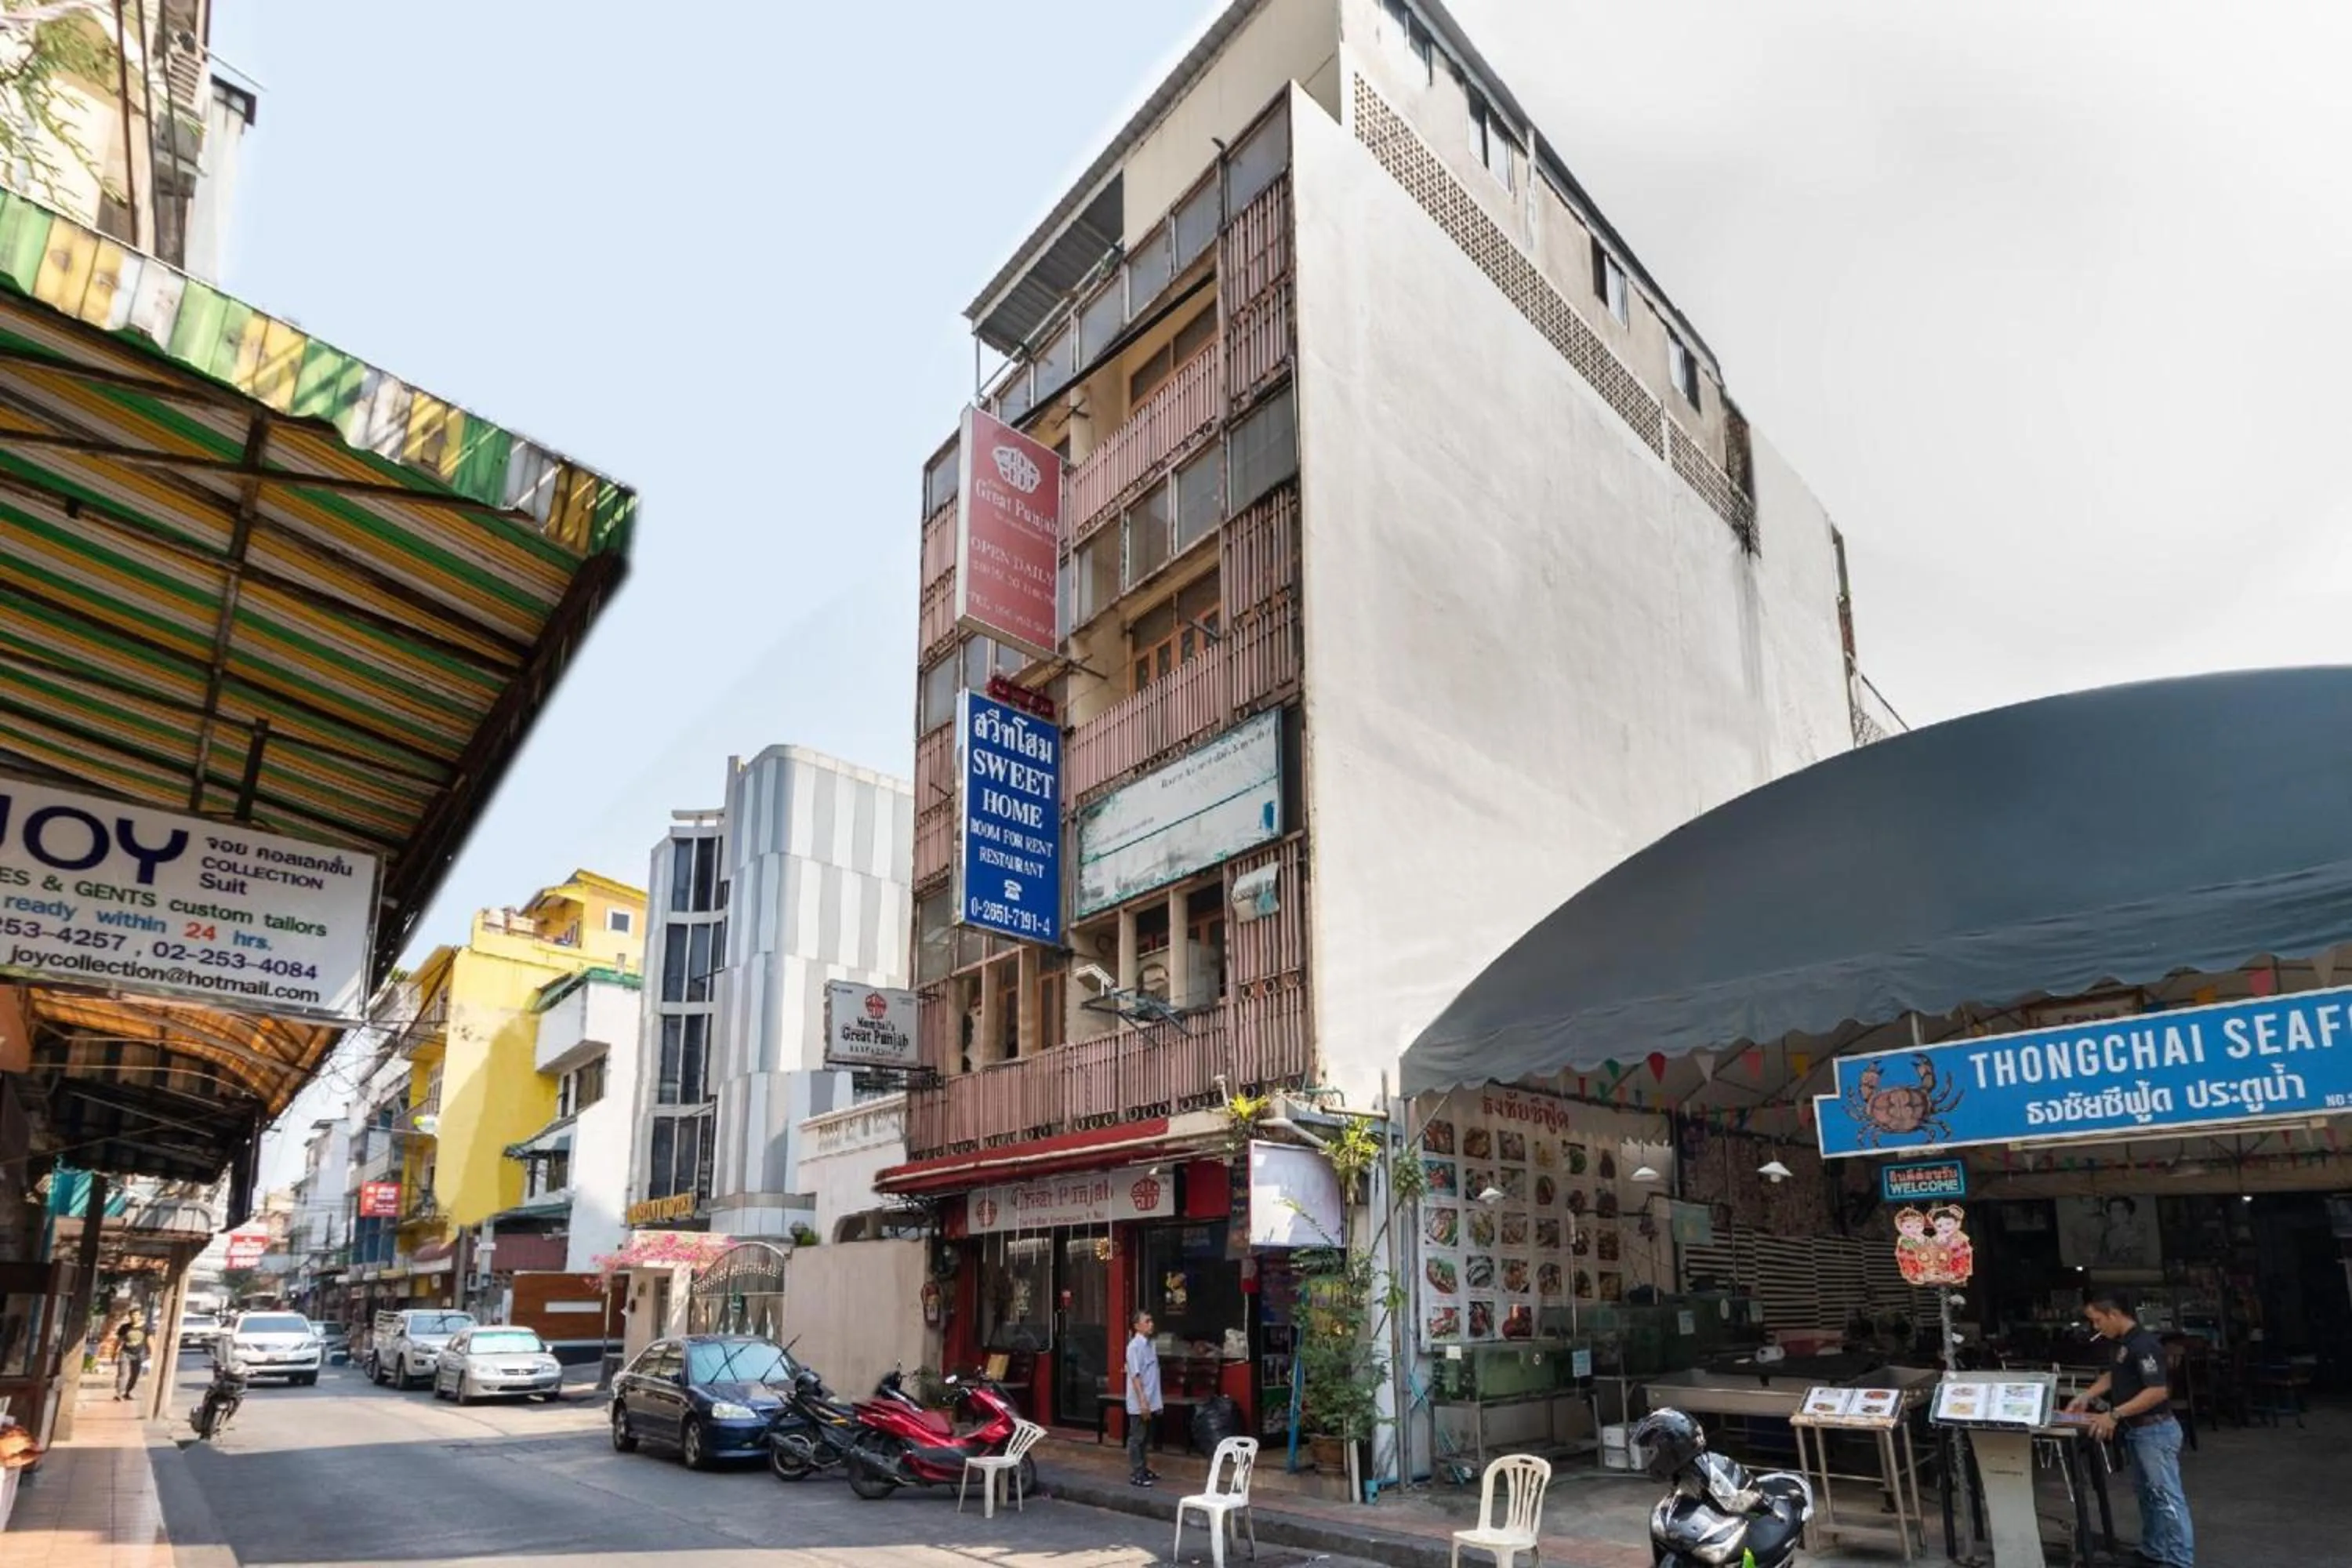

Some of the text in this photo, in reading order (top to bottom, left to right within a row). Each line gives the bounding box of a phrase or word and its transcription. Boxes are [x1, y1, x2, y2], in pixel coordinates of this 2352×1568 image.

[975, 708, 1052, 764] สวีทโฮม
[973, 748, 1055, 800] SWEET
[982, 787, 1043, 829] HOME
[205, 836, 249, 856] จอย
[969, 816, 1054, 858] ROOM FOR RENT
[199, 871, 248, 895] Suit
[201, 856, 324, 891] COLLECTION
[979, 846, 1045, 879] RESTAURANT
[4, 895, 274, 952] ready within 24 hrs.
[42, 874, 64, 892] &
[74, 880, 157, 908] GENTS
[169, 898, 253, 924] custom
[263, 913, 328, 937] tailors
[7, 944, 321, 1003] joycollection@hotmail.com
[152, 941, 318, 980] 02-253-4084
[842, 1024, 873, 1044] Great
[1969, 1024, 2205, 1090] THONGCHAI
[2027, 1062, 2307, 1124] ธงชัยซีฟู้ด ประตูน้ำ
[1889, 1178, 1958, 1196] WELCOME
